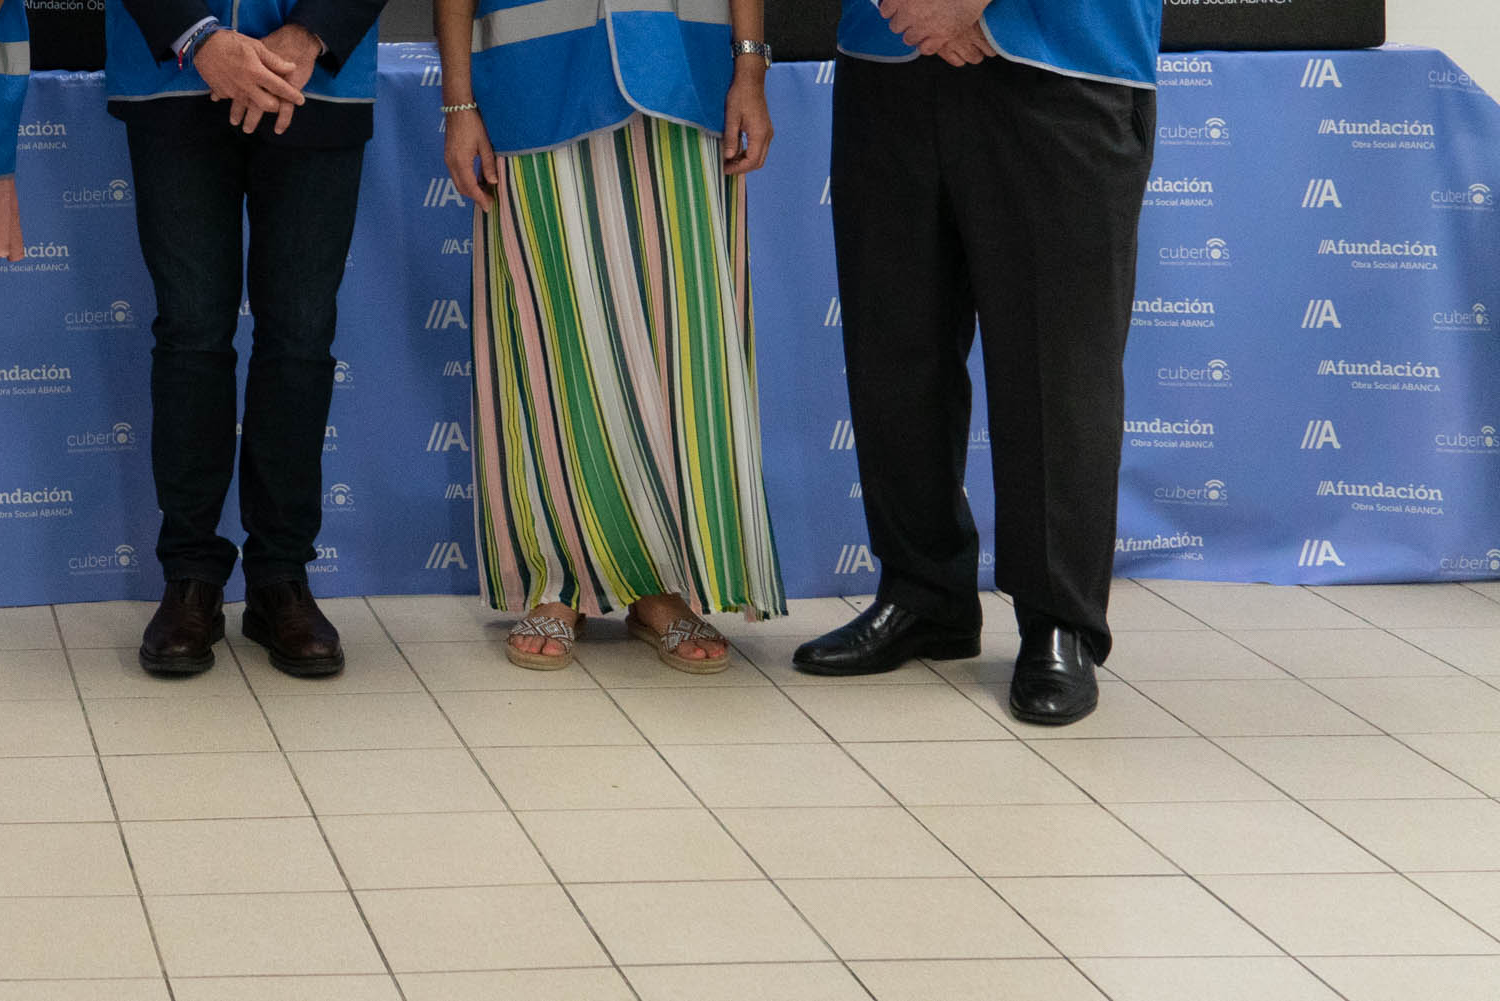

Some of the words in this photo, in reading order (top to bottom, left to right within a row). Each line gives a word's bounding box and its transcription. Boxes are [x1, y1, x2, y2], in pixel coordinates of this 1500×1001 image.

[1157, 78, 1177, 86] ocial
[1159, 125, 1229, 139] cubertos
[1352, 140, 1371, 148] Obra
[1373, 140, 1396, 148] Social
[1399, 141, 1435, 150] ABANCA
[1159, 246, 1230, 259] cubertos
[1352, 260, 1371, 268] Obra
[1373, 261, 1397, 269] Social
[1400, 262, 1438, 270] ABANCA
[1158, 366, 1231, 380] cubertos
[1374, 382, 1399, 390] Social
[1402, 383, 1440, 392] ABANCA
[1131, 439, 1152, 447] Obra
[1154, 439, 1177, 448] Social
[1180, 440, 1214, 448] ABANCA
[1155, 485, 1228, 500] cubertos
[1352, 502, 1374, 511] Obra
[1376, 503, 1402, 512] Social
[1404, 505, 1444, 515] ABANCA
